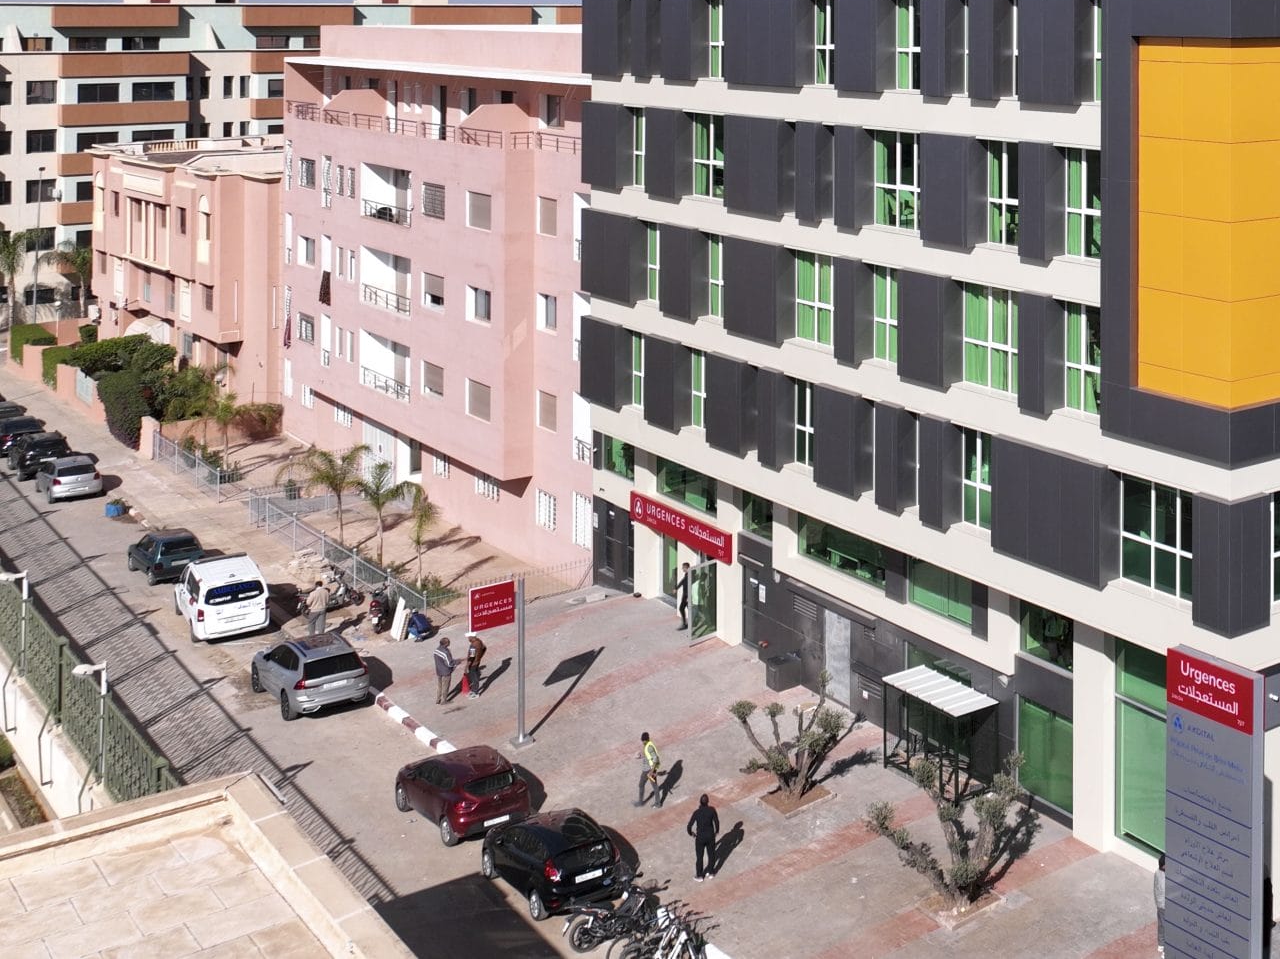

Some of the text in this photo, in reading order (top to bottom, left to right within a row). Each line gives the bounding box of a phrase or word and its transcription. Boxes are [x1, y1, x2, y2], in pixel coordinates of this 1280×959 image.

[646, 503, 686, 530] URGENCES
[474, 597, 512, 611] URGENCES
[1181, 660, 1236, 694] Urgences
[1178, 684, 1238, 716] المستعجلات
